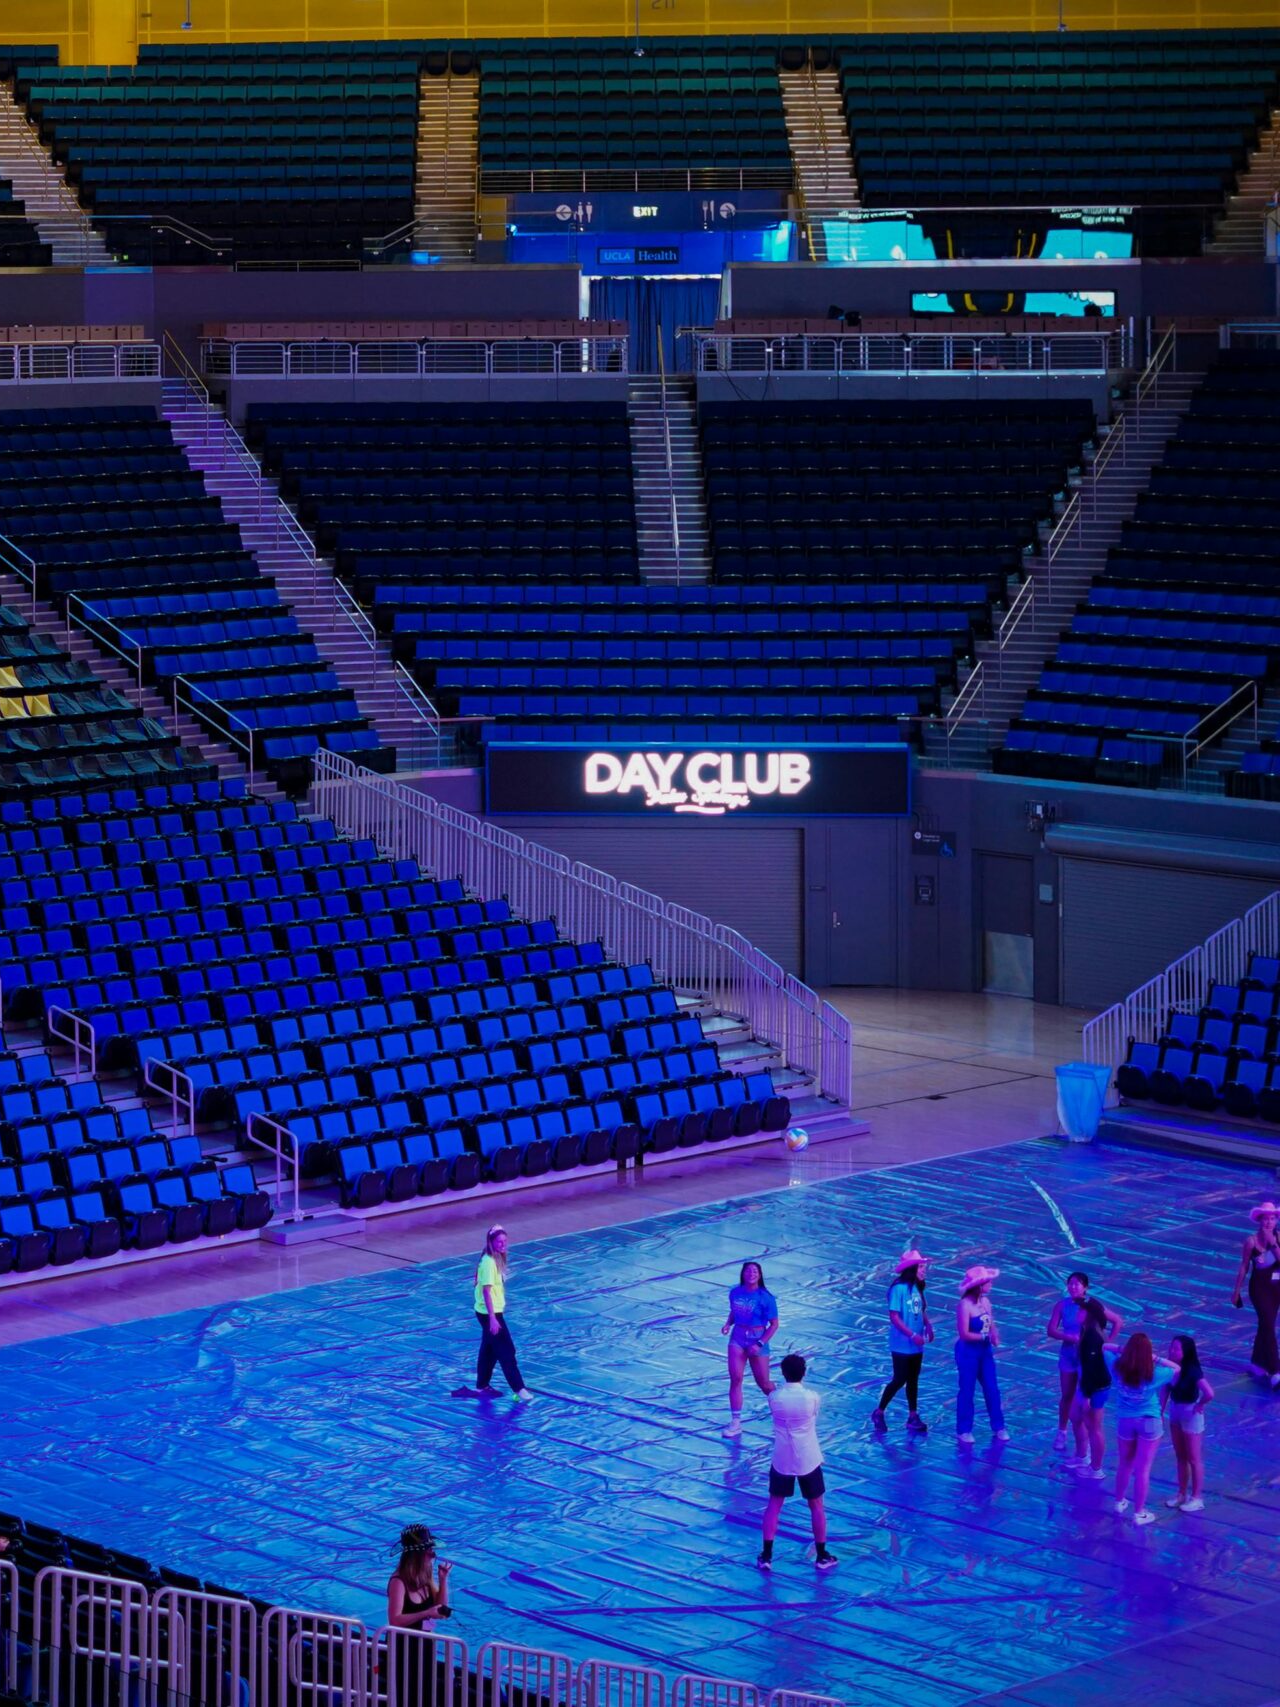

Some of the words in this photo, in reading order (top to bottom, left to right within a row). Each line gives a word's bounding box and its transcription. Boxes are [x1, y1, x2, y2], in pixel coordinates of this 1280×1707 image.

[632, 206, 658, 217] EXIT
[604, 252, 631, 261] UCLA
[638, 250, 677, 261] Health
[584, 753, 684, 794] DAY
[686, 752, 812, 795] CLUB
